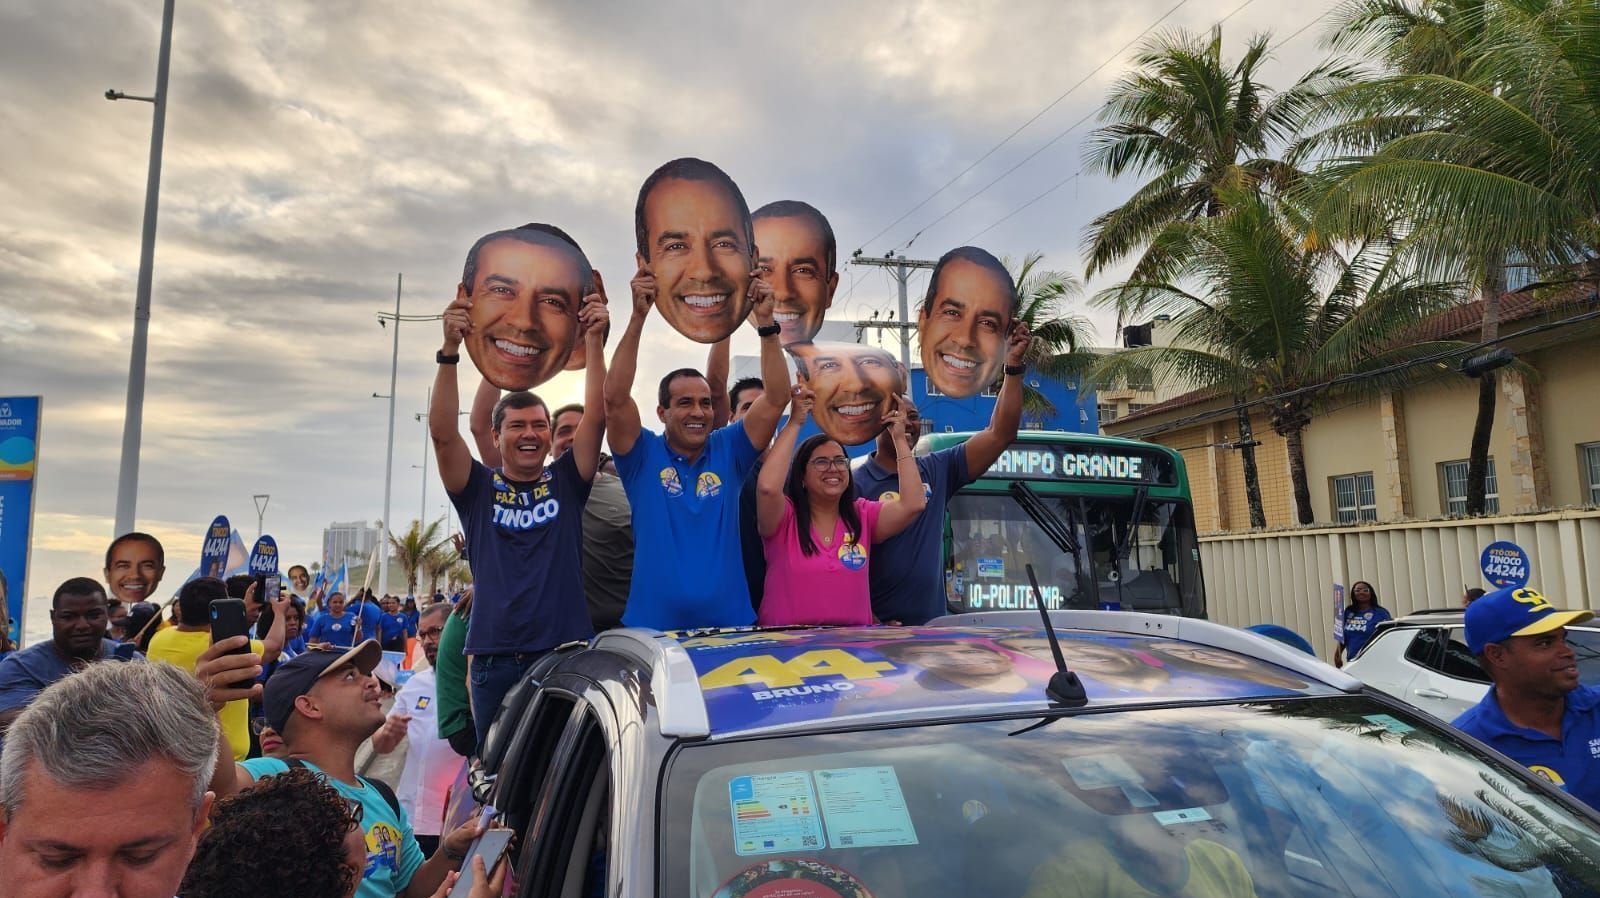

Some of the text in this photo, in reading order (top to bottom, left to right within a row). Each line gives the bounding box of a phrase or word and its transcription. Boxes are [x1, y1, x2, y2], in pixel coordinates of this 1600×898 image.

[1062, 454, 1142, 479] GRANDE
[495, 491, 517, 505] FAZ
[533, 484, 550, 500] DE
[492, 498, 560, 529] TINOCO
[204, 537, 230, 557] 44244
[251, 554, 278, 572] 44244
[1485, 563, 1525, 579] 44244
[1489, 555, 1522, 567] TINOCO
[699, 648, 898, 689] 44
[751, 681, 856, 701] BRUNO
